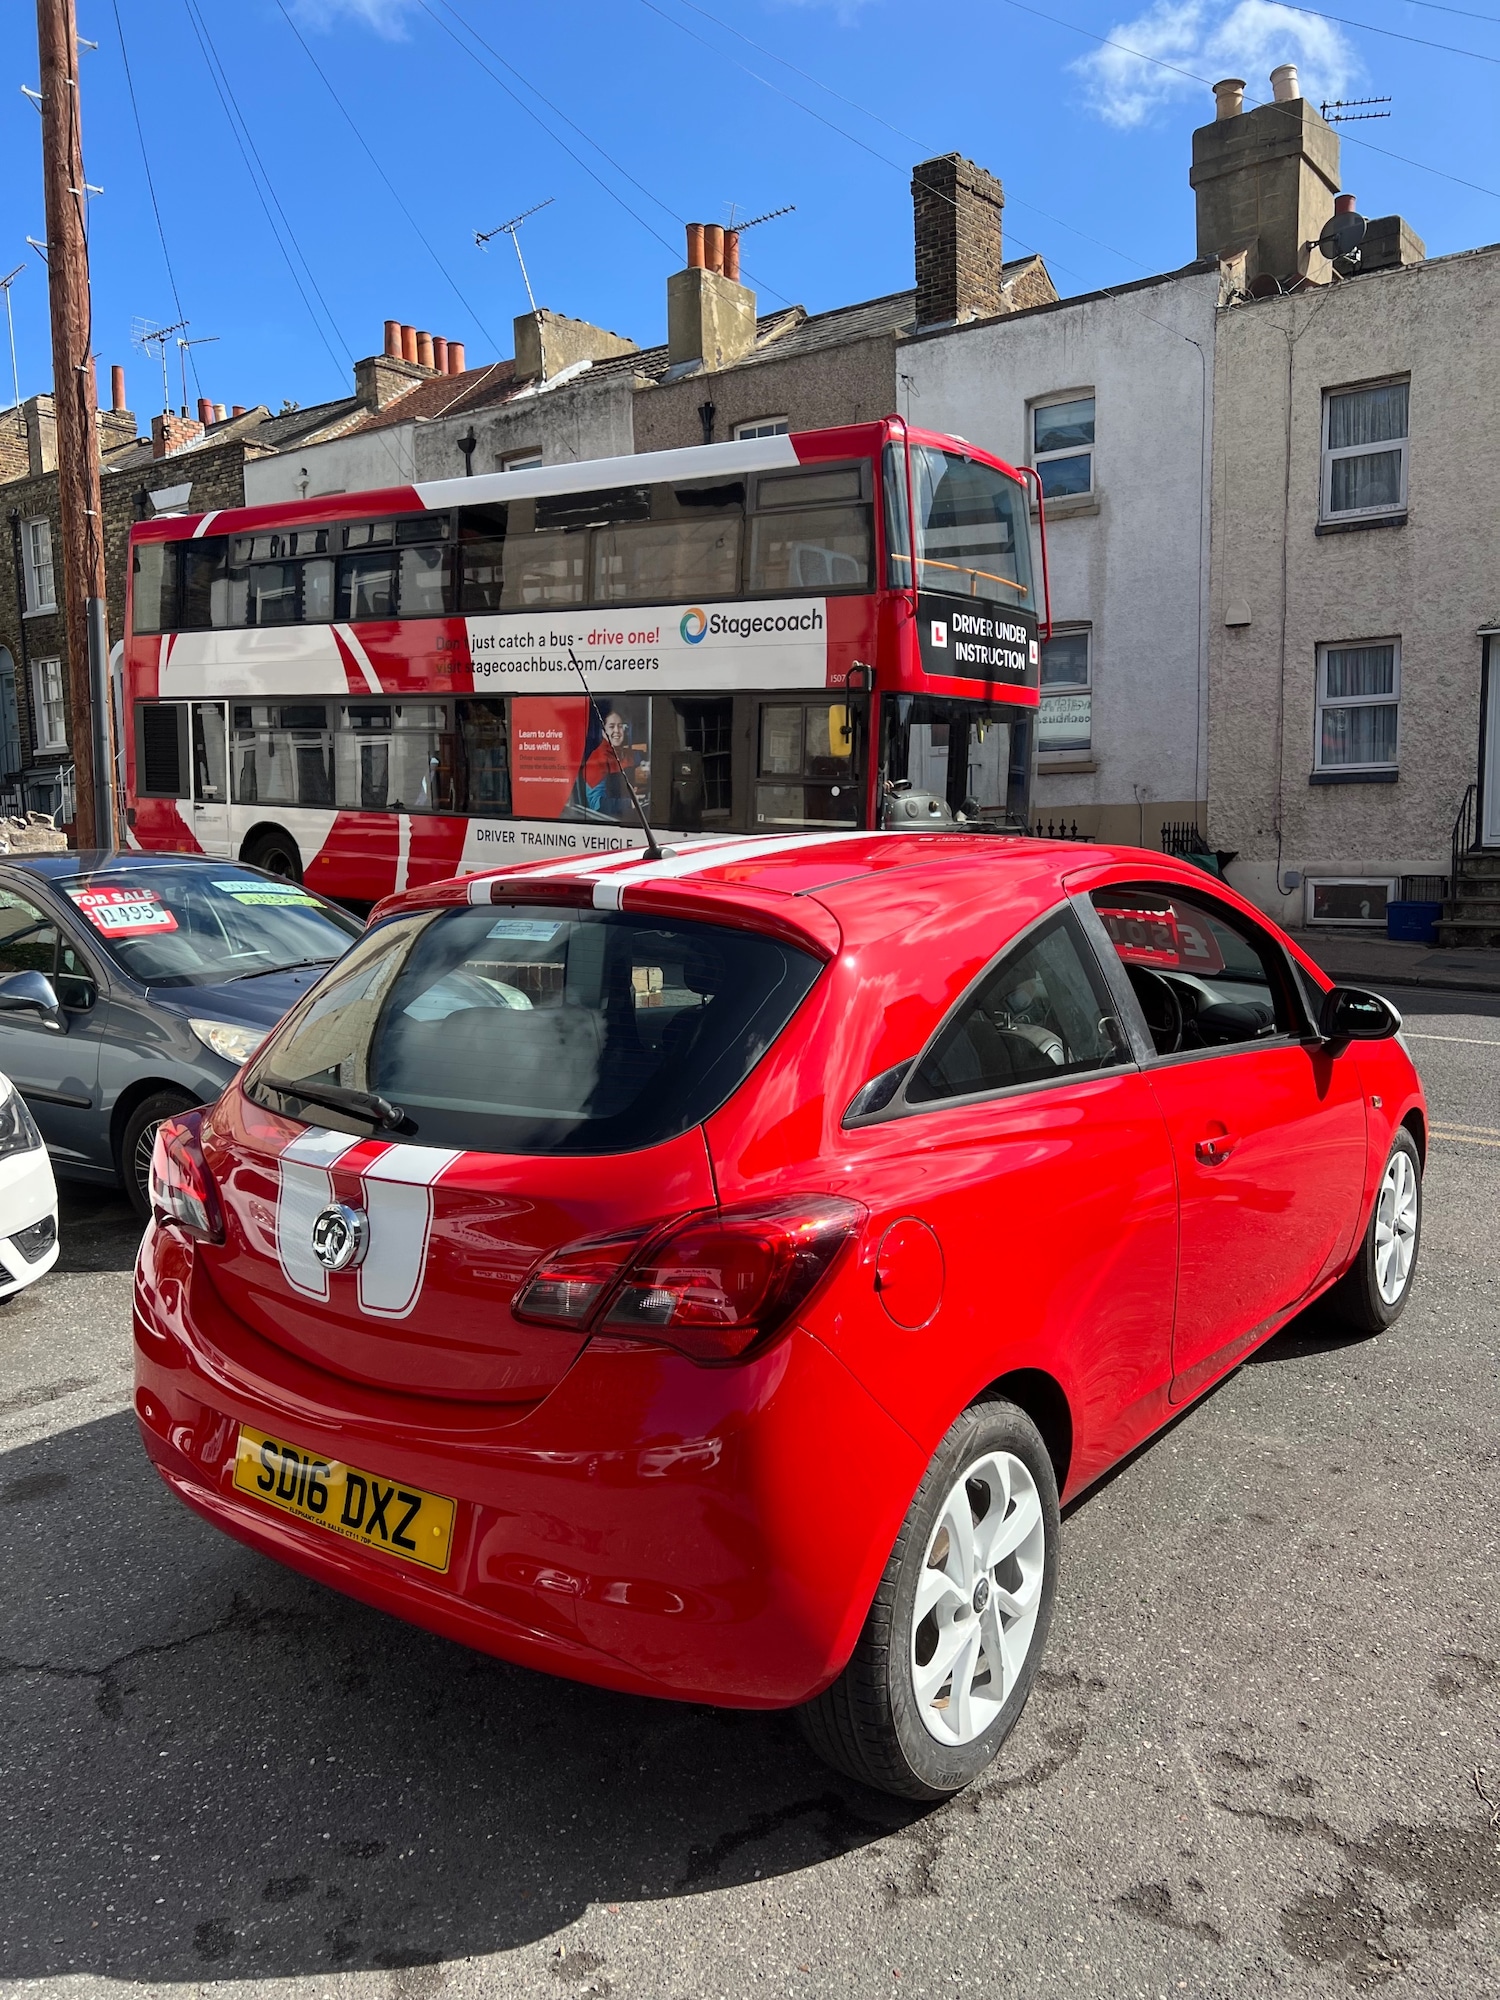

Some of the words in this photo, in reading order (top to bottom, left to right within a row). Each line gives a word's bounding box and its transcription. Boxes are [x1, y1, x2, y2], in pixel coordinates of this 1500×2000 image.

[709, 608, 824, 638] Stagecoach
[935, 626, 944, 642] L
[952, 612, 994, 638] DRIVER
[995, 620, 1027, 645] UNDER
[471, 634, 496, 653] just
[498, 632, 535, 649] catch
[538, 635, 547, 647] a
[549, 631, 575, 647] bus
[586, 629, 624, 645] drive
[627, 627, 660, 643] one!
[435, 658, 463, 674] visit
[465, 655, 660, 677] stagecoachbus.com/careers
[955, 641, 1026, 671] INSTRUCTION
[830, 674, 850, 683] 1507
[518, 729, 537, 738] Learn
[537, 730, 546, 738] to
[545, 729, 563, 739] drive
[523, 741, 536, 751] bus
[536, 742, 551, 751] with
[551, 743, 560, 751] us
[476, 829, 515, 844] DRIVER
[521, 832, 576, 848] TRAINING
[582, 836, 633, 851] VEHICLE
[71, 894, 110, 907] FOR
[110, 889, 155, 903] SALE
[103, 905, 155, 923] 1495
[256, 1440, 331, 1514] SD16
[340, 1472, 422, 1551] DXZ
[289, 1506, 315, 1521] ELEPHANT
[315, 1518, 327, 1528] CAR
[327, 1523, 345, 1534] SALES
[345, 1530, 359, 1540] CT11
